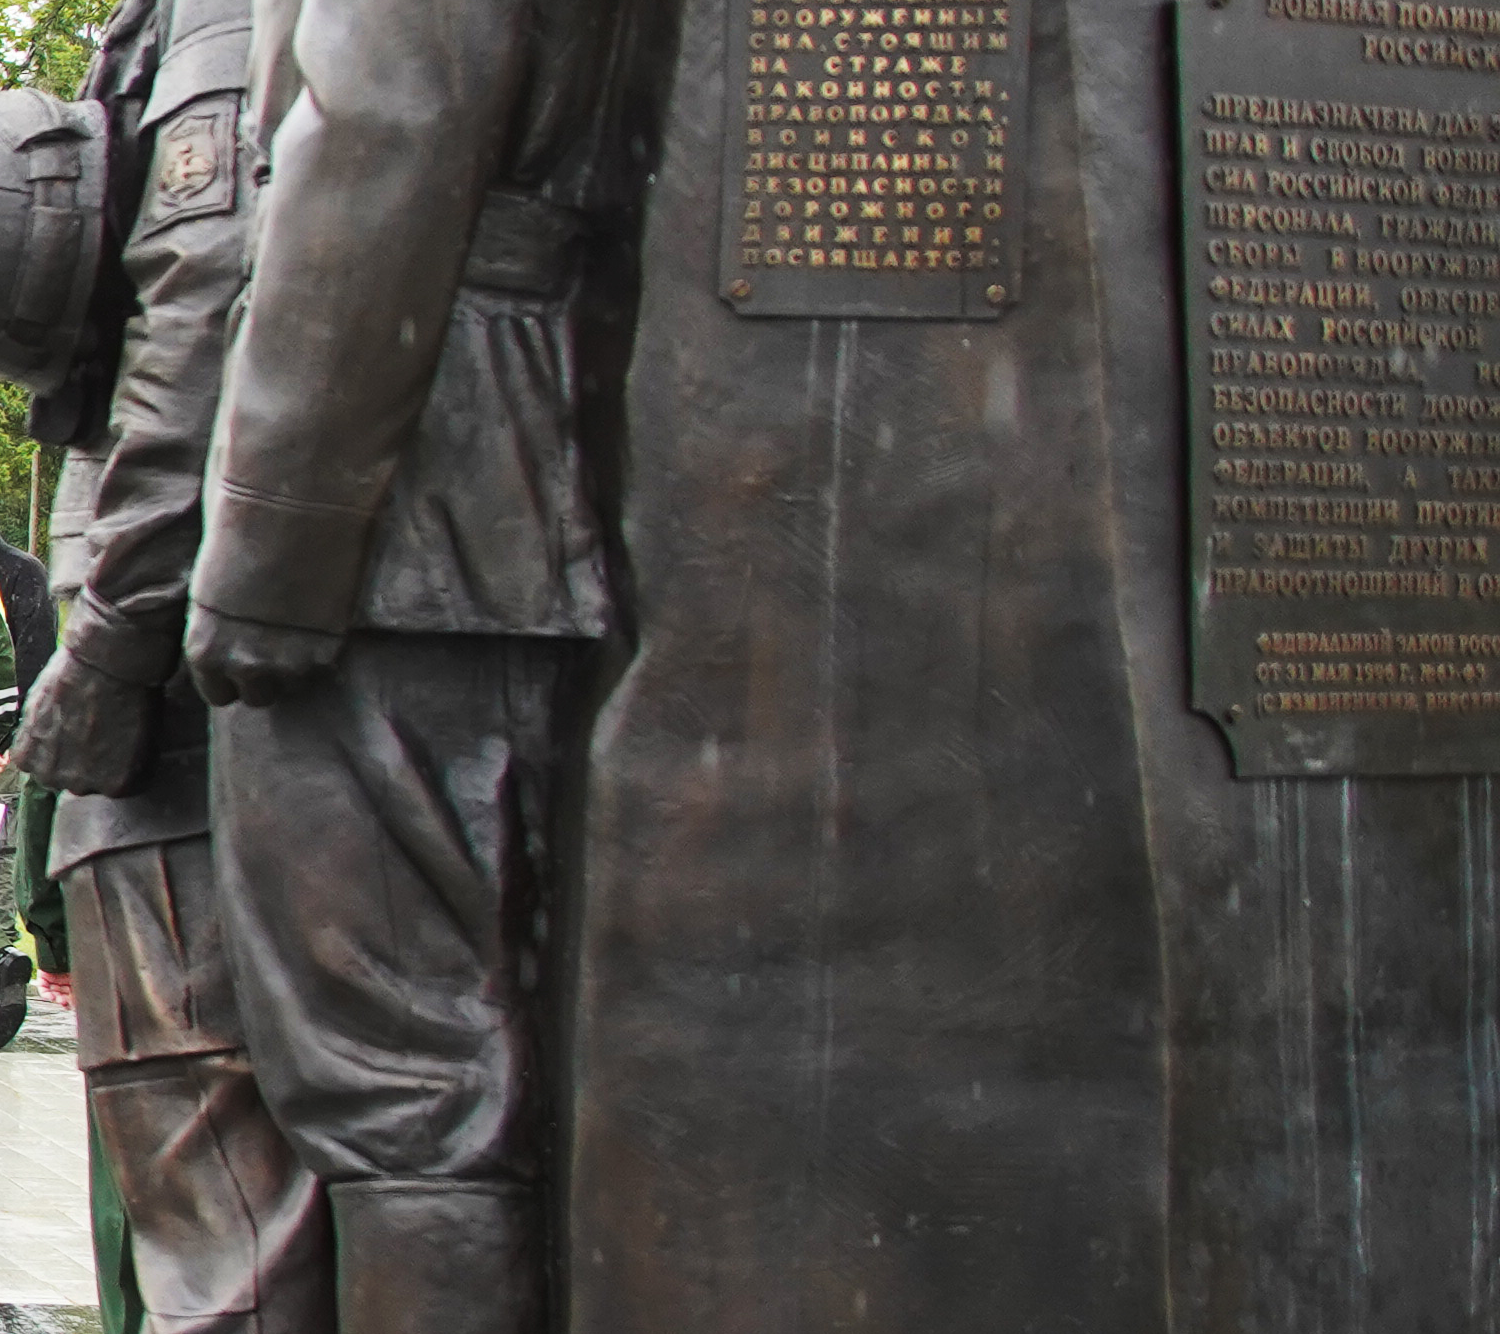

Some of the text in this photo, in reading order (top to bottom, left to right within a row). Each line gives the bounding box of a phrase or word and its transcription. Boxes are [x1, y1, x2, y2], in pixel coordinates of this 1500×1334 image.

[751, 7, 1009, 29] ВООРУЖЕННЫХ
[750, 31, 1009, 54] СИЛ, СТОЯЩИМ
[750, 54, 967, 77] НА СТРАЖЕ
[747, 79, 1010, 101] ЗАКОННОСТИ,
[747, 103, 1009, 125] ПРАВОПОРЯДКА,
[747, 123, 1005, 148] ВОИНСКОЙ
[1204, 129, 1269, 156] ПРАВ
[1282, 135, 1299, 161] И
[1310, 136, 1403, 165] СВОБОД
[747, 150, 1004, 173] ДИСЦИПЛИНЫ И
[744, 175, 1003, 196] БЕЗОПАСНОСТИ
[1204, 167, 1257, 193] СИЛ
[1266, 169, 1426, 203] РОССИЙСКОЙ
[744, 199, 1002, 220] ДОРОЖНОГО
[1208, 238, 1300, 265] СБОРЫ
[1210, 312, 1483, 348] СИЛАХ РОССИЙСКОЙ
[1213, 383, 1407, 415] БЕЗОПАСНОСТИ
[1212, 421, 1352, 451] ОБЪЕКТОВ
[1254, 532, 1367, 561] ЗАЩИТЫ
[1390, 534, 1488, 565] ДРУГИХ
[1256, 627, 1393, 655] ФЕДЕРАЛЬНЫЙ
[1396, 634, 1455, 655] ЗАКОН
[1256, 662, 1282, 682] ОТ
[1311, 663, 1351, 682] МАЯ
